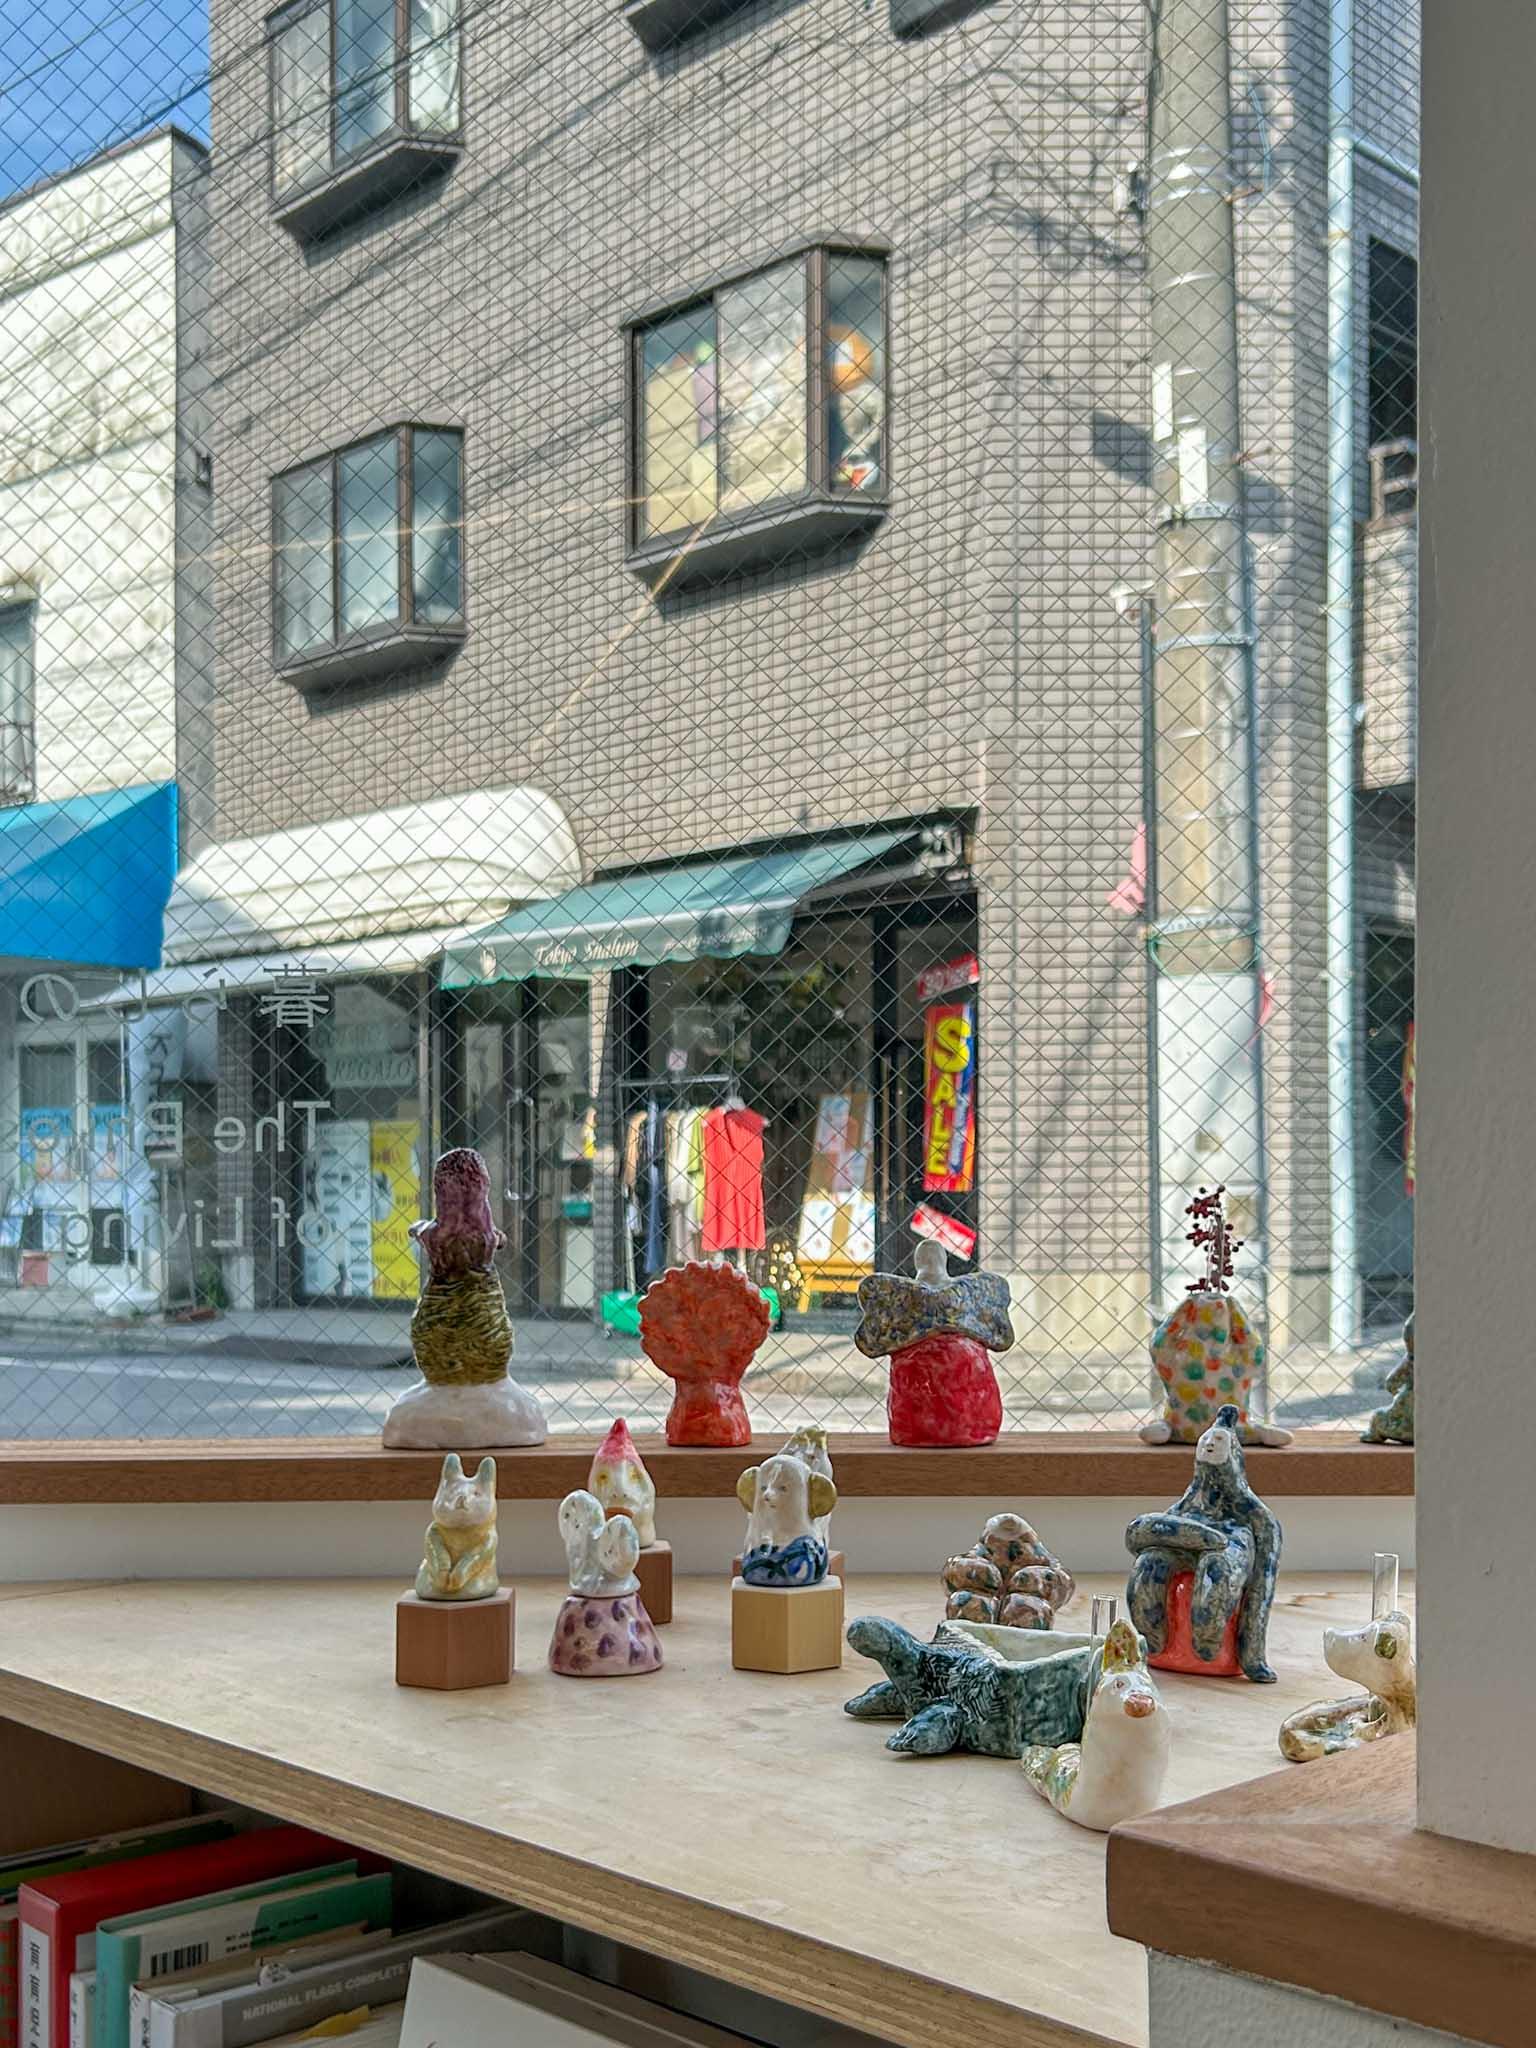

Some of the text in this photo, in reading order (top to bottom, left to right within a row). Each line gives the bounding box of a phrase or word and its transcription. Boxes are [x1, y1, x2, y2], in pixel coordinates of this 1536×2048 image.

[927, 1016, 971, 1175] SALE
[242, 1994, 303, 2021] NATIONAL
[345, 1962, 408, 1990] COMPLETE
